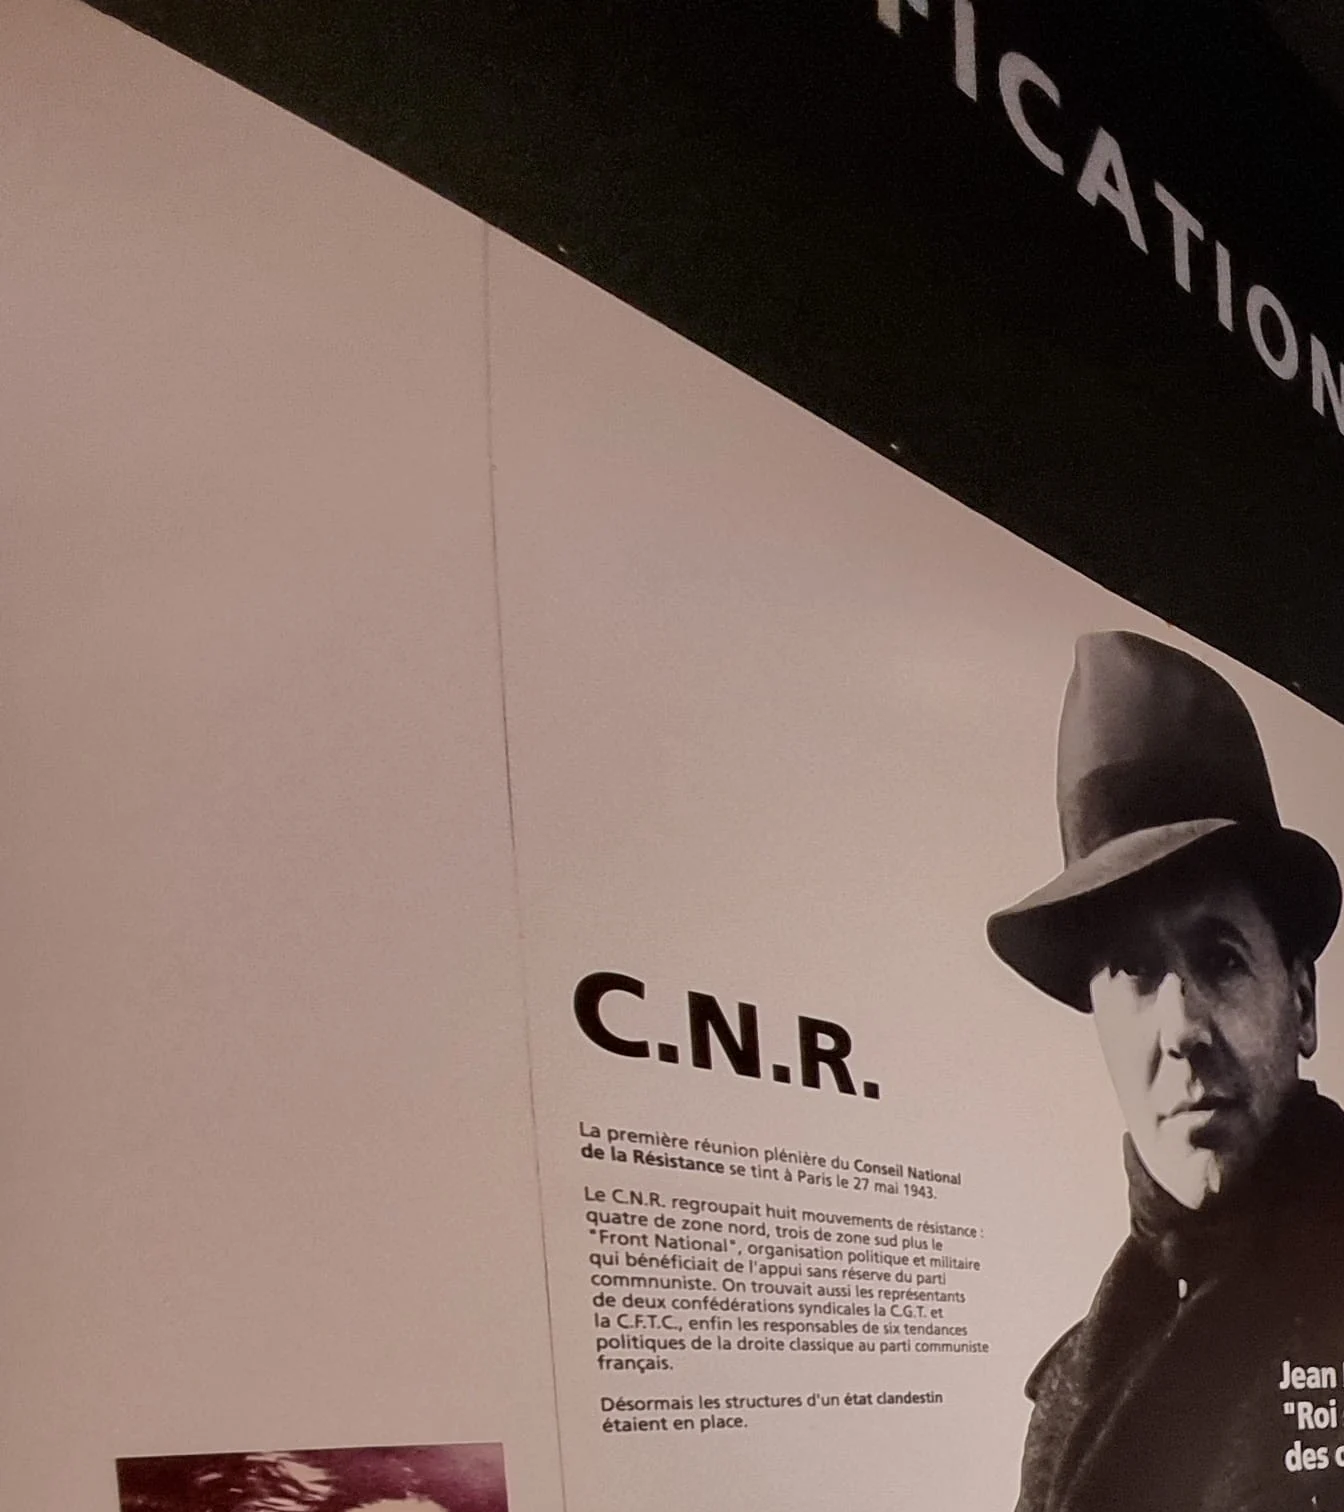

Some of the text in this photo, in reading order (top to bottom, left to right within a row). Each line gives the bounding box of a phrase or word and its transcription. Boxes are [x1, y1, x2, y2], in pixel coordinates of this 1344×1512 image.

[573, 971, 880, 1100] C.N.R.
[579, 1121, 962, 1186] La première réunion plénière du Conseil National
[580, 1142, 937, 1200] de la Résistance se tint à Paris le 27 mai 1943.
[584, 1186, 606, 1203] Le
[611, 1188, 666, 1208] C.N.R.
[671, 1198, 762, 1218] regroupait
[765, 1203, 798, 1221] huit
[802, 1210, 894, 1230] mouvements
[896, 1217, 913, 1232] de
[917, 1220, 977, 1238] résistance
[585, 1210, 943, 1252] quatre de zone nord, trois de zone sud plus le
[588, 1228, 649, 1248] "Front
[747, 1244, 843, 1261] organisation
[848, 1249, 910, 1268] politique
[912, 1255, 926, 1267] et
[929, 1256, 981, 1271] militaire
[588, 1250, 946, 1286] qui bénéficiait de l'appui sans réserve du parti
[592, 1291, 944, 1319] de deux confédérations syndicales la C.G.T. et
[722, 1278, 746, 1293] On
[750, 1280, 813, 1296] trouvait
[817, 1284, 851, 1298] aussi
[855, 1284, 874, 1299] les
[878, 1288, 966, 1304] représentants
[594, 1312, 968, 1336] la C.F.T.C., enfin les responsables de six tendances
[596, 1333, 990, 1355] politiques de la droite classique au parti communiste
[596, 1354, 674, 1374] français.
[1279, 1360, 1337, 1390] Jean
[600, 1390, 943, 1412] Désormais les structures d'un état clandestin
[1283, 1399, 1337, 1430] "Roi
[602, 1414, 748, 1433] étaient en place.
[1284, 1440, 1329, 1472] des
